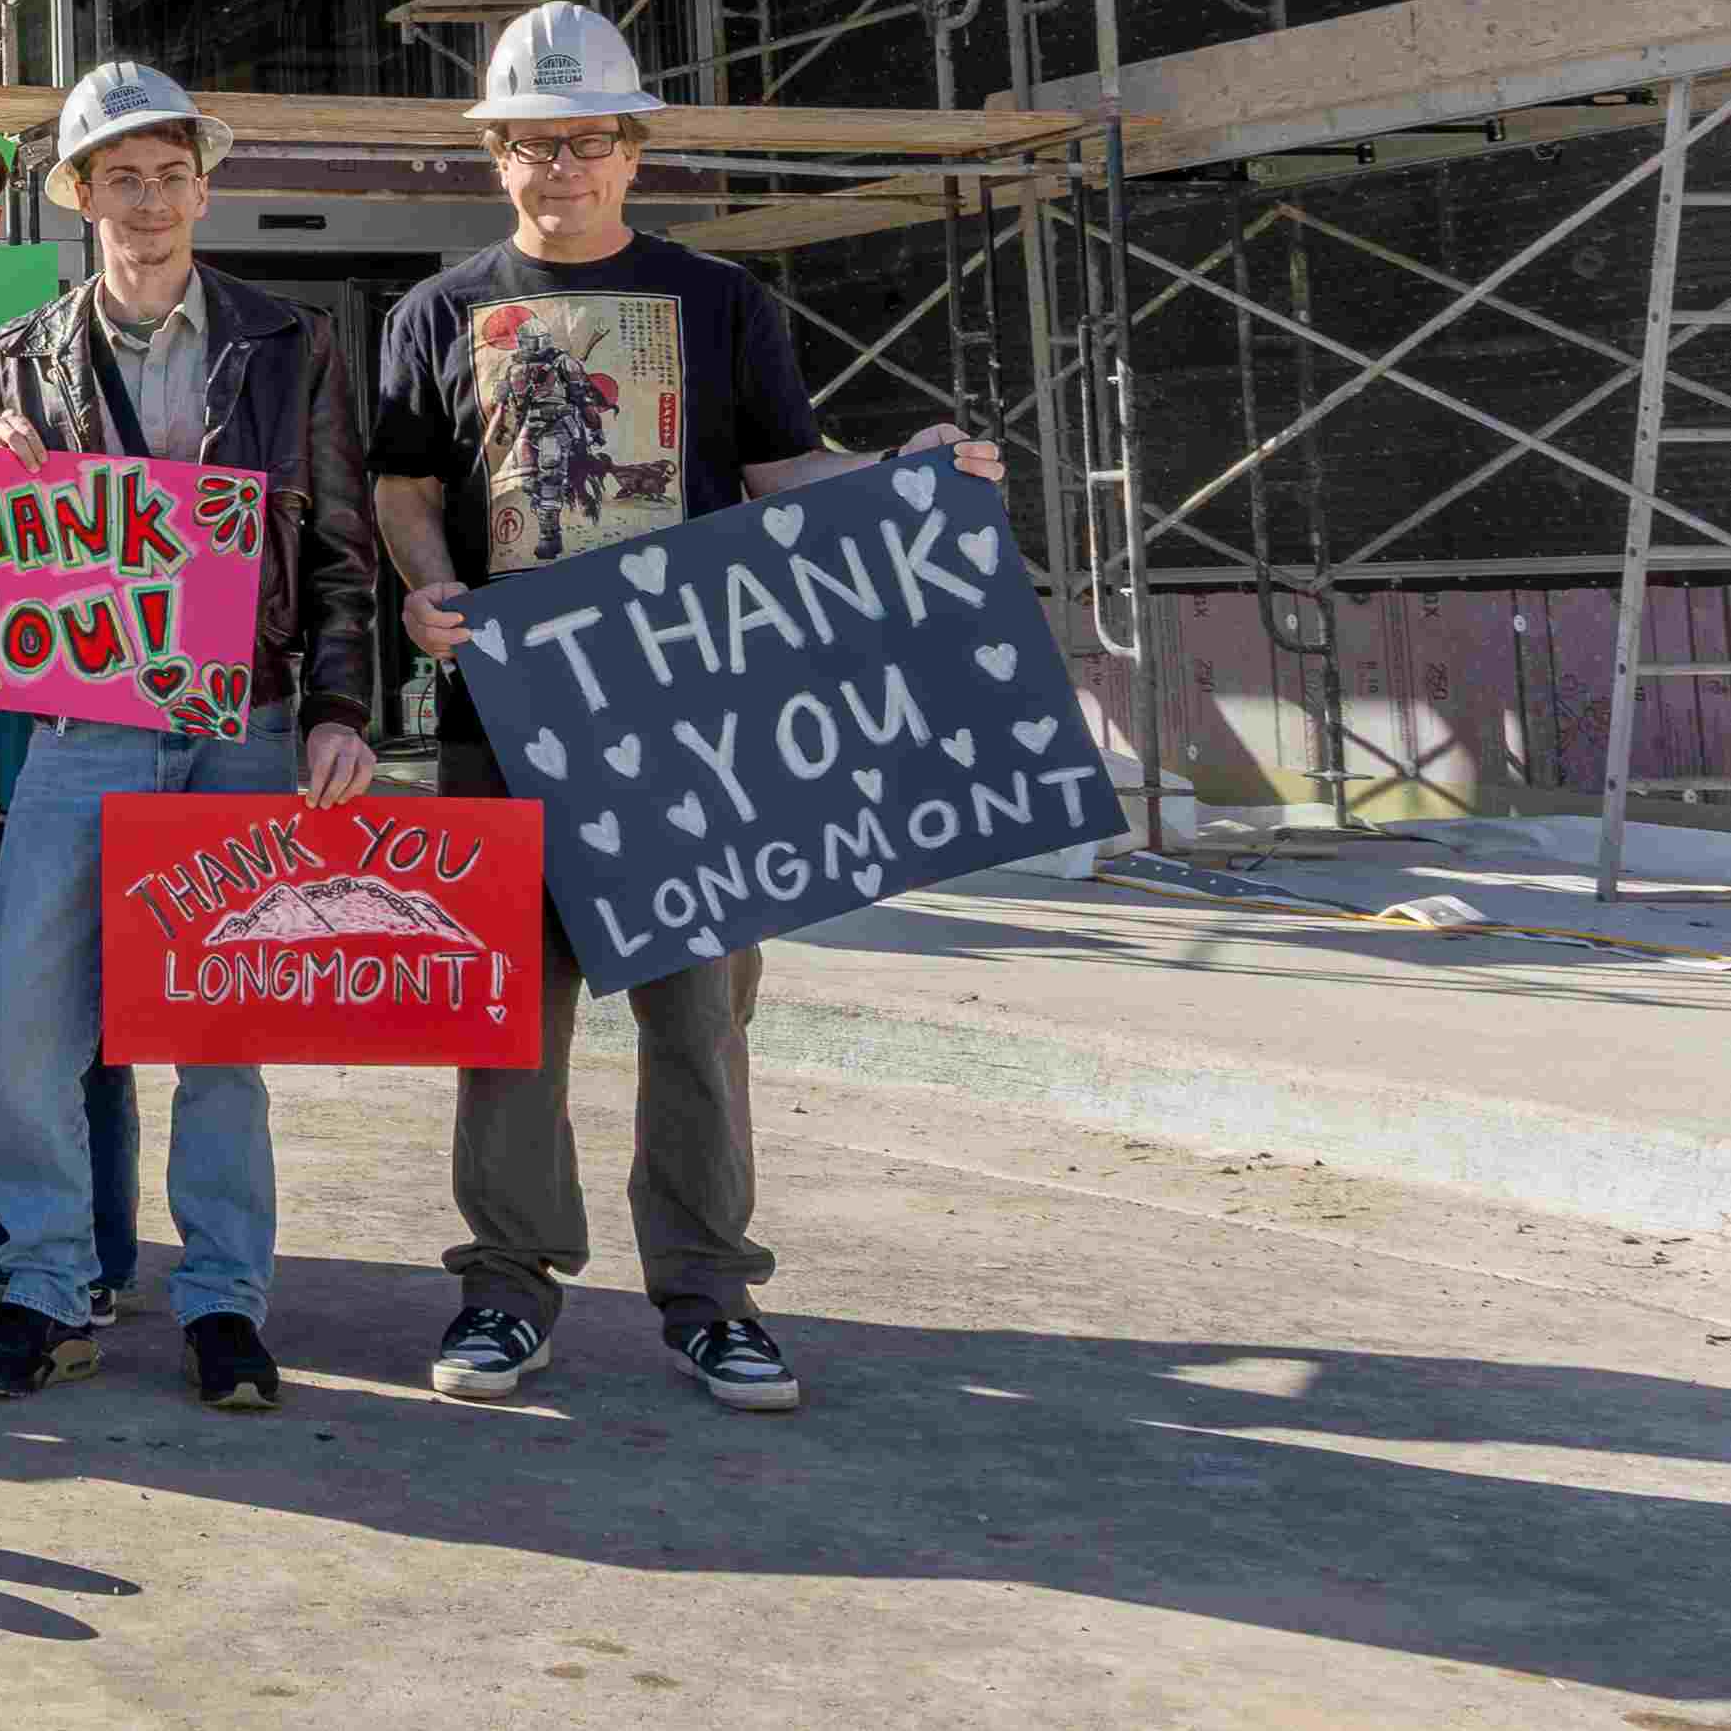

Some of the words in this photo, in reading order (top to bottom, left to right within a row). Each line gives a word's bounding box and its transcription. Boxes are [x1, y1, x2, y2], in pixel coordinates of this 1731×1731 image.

[103, 97, 151, 118] MUSEUM
[533, 74, 583, 86] MUSEUM
[523, 508, 986, 715] THANK
[125, 811, 326, 940] THANK
[351, 813, 483, 882] YOU
[593, 766, 1097, 959] LONGMONT
[163, 943, 508, 1025] LONGMONT!
